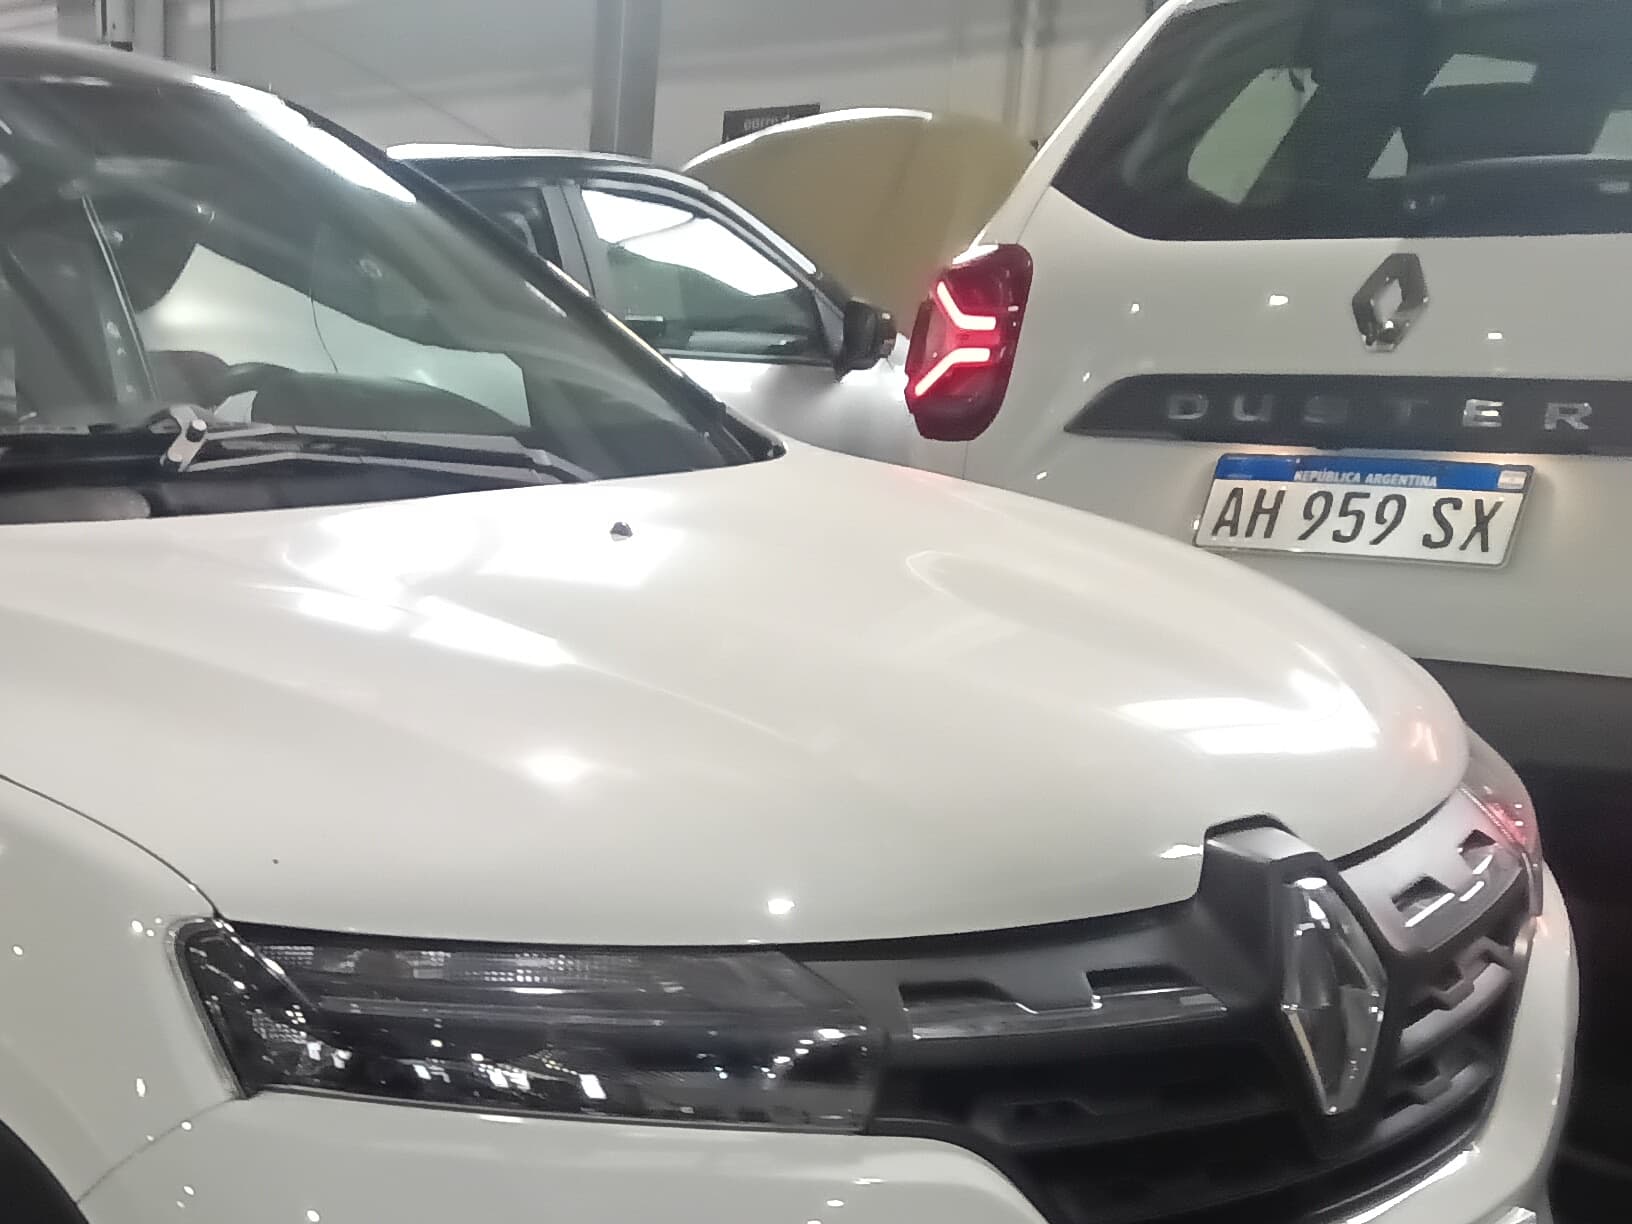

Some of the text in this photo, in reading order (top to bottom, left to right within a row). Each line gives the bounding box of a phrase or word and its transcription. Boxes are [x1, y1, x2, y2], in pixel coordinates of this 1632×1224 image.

[1168, 393, 1593, 431] DUSTER
[1365, 473, 1437, 487] ARGENTINA
[1211, 487, 1503, 553] AH 959 SX
